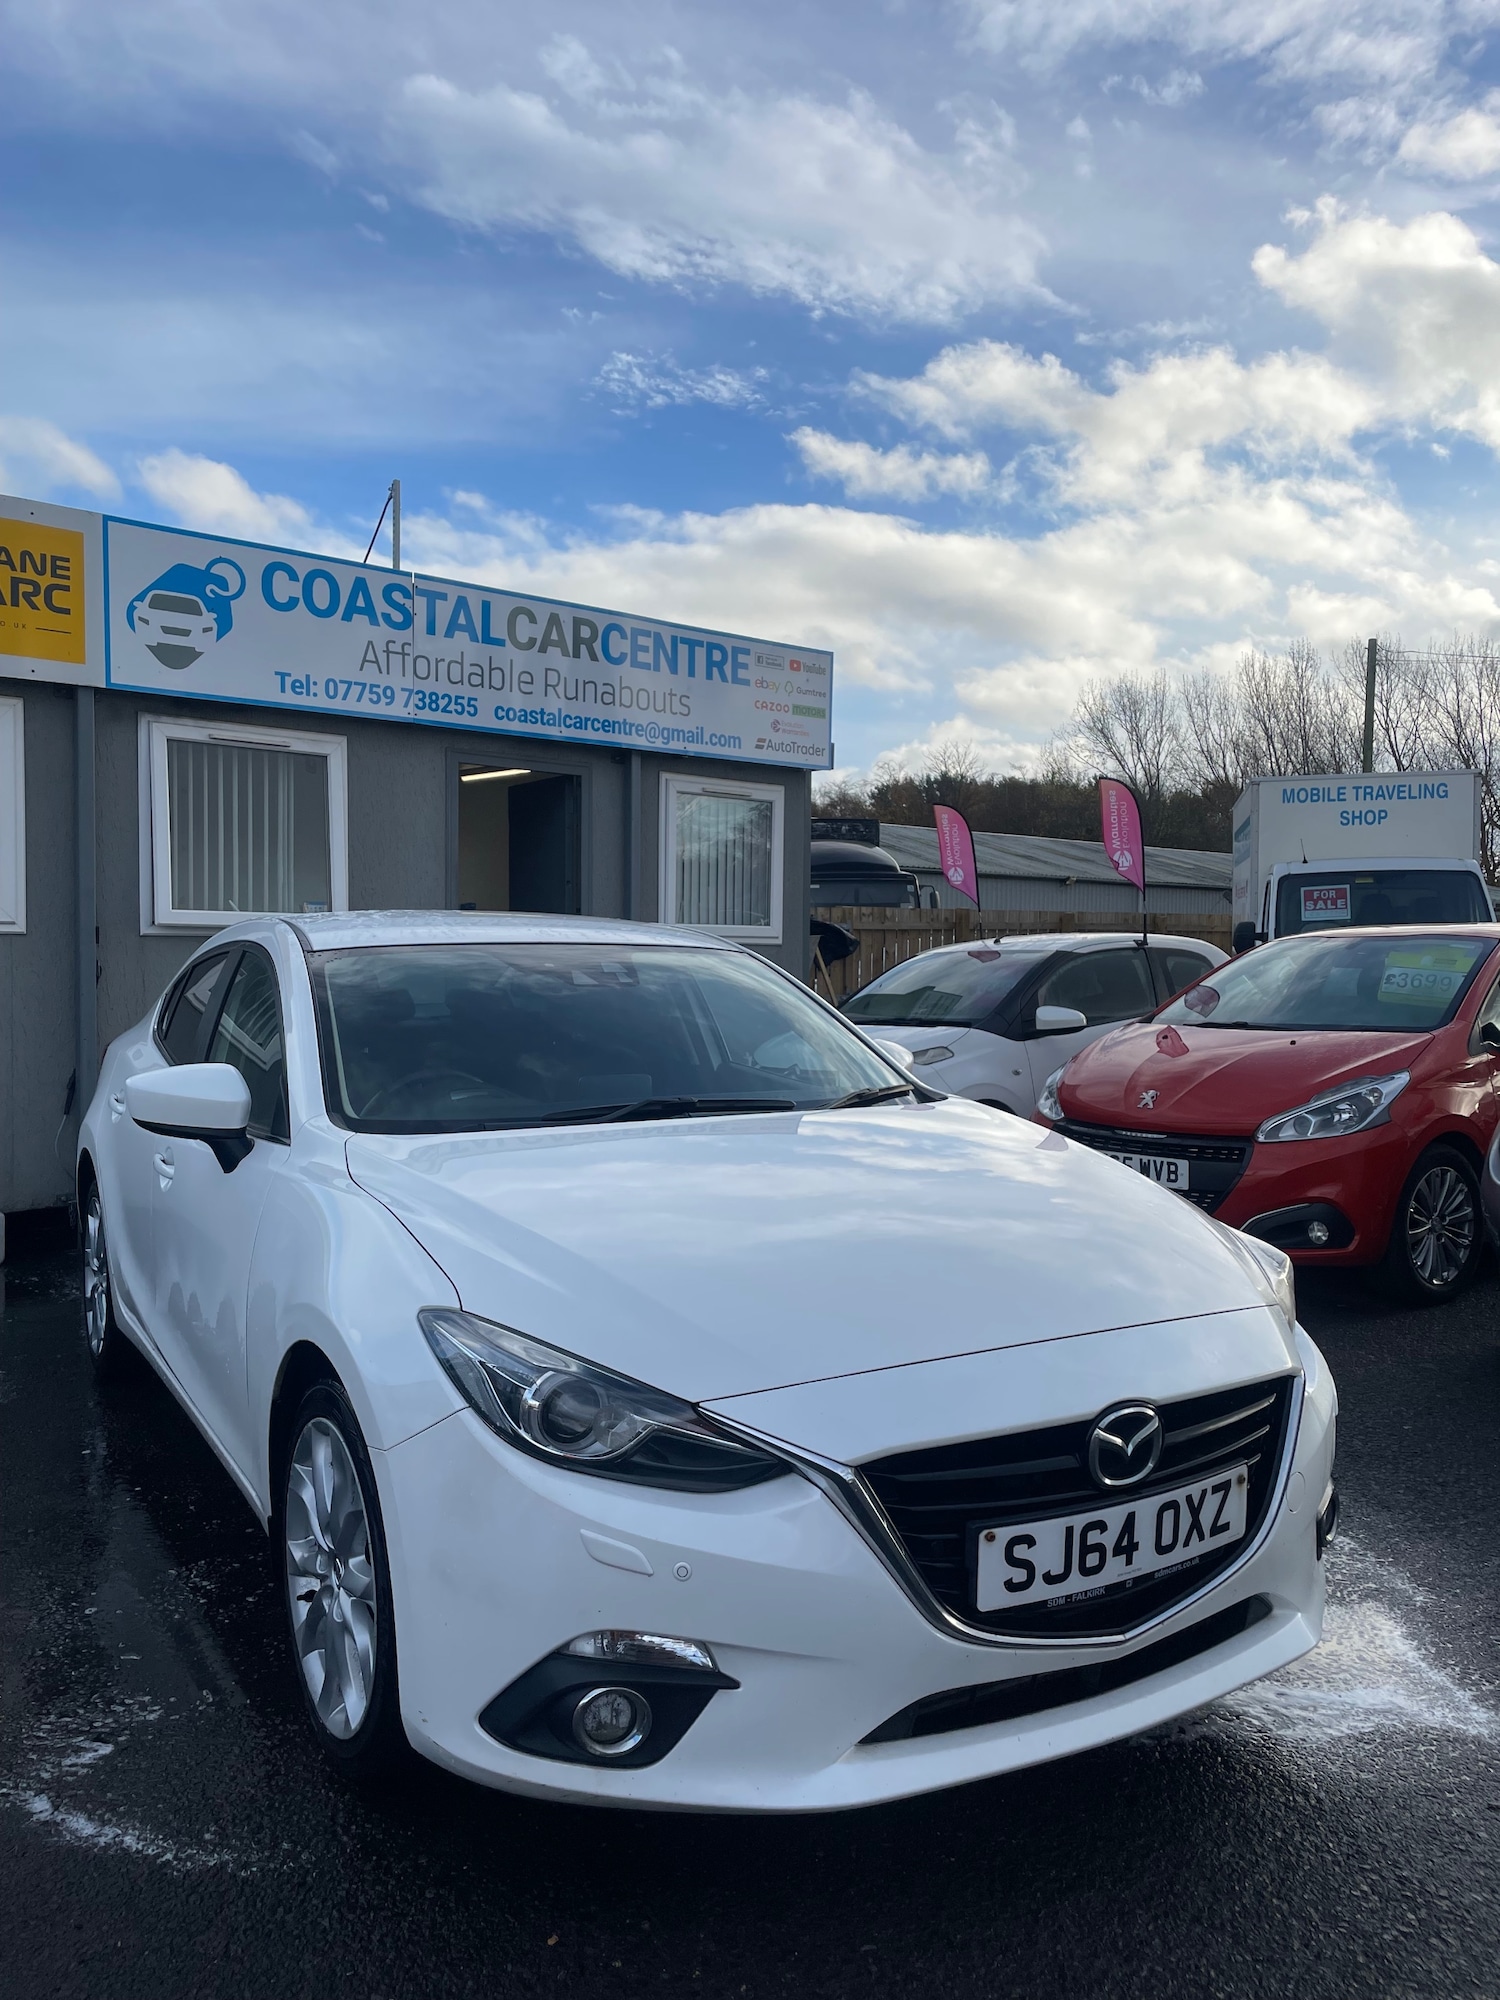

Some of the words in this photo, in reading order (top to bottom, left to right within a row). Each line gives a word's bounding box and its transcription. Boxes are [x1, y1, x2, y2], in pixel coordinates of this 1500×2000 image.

[0, 576, 71, 615] RC
[261, 561, 751, 686] COASTALCARCENTRE
[802, 661, 826, 676] YouTube
[359, 639, 534, 695] Affordable
[544, 667, 691, 717] Runabouts
[754, 676, 780, 693] ebay
[796, 686, 827, 698] Gumtree
[274, 671, 318, 698] Tel:
[324, 678, 395, 706] 07759
[400, 687, 478, 717] 738255
[494, 704, 742, 749] coastalcarcentre@gmail.com
[754, 699, 790, 713] CAZOO
[766, 739, 826, 757] AutoTrader
[1282, 786, 1347, 804] MOBILE
[1352, 782, 1449, 801] TRAVELING
[1340, 809, 1388, 826] SHOP
[1313, 890, 1336, 899] FOR
[1305, 899, 1346, 910] SALE
[1383, 972, 1452, 992] £3699
[1140, 1157, 1179, 1183] WVB
[1003, 1511, 1140, 1593] SJ64
[1154, 1478, 1232, 1556] OXZ
[1047, 1597, 1066, 1608] SDM
